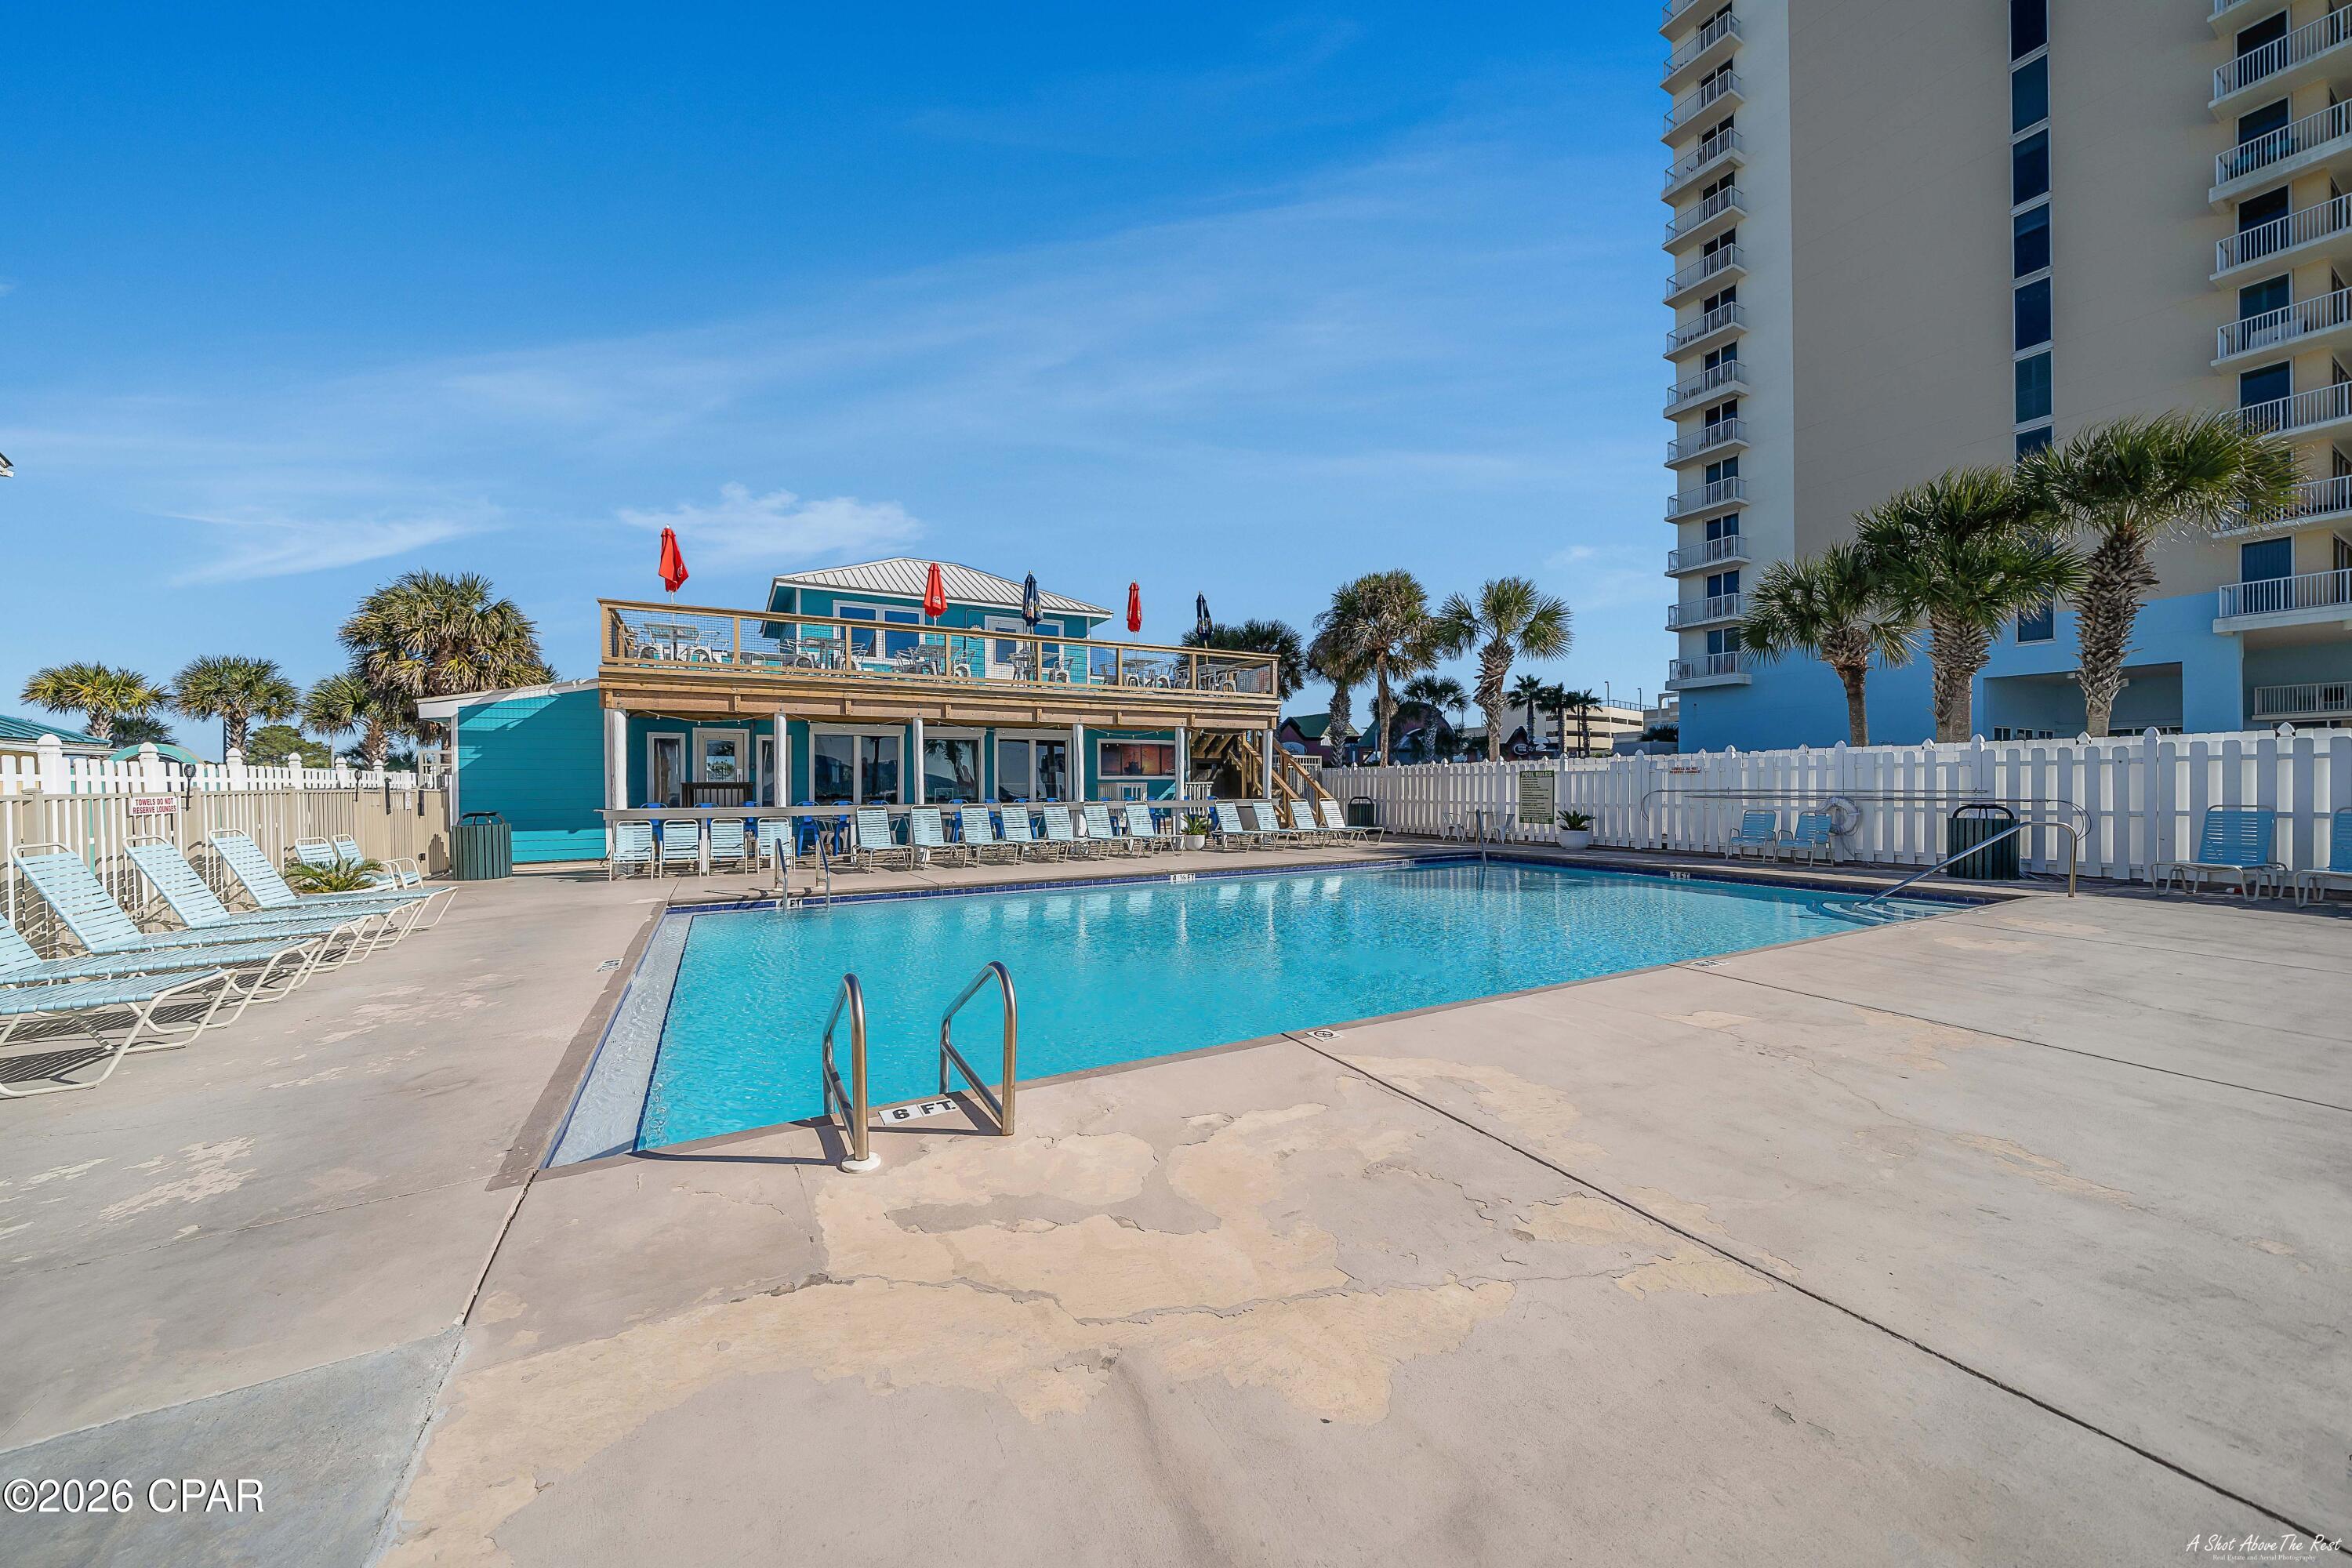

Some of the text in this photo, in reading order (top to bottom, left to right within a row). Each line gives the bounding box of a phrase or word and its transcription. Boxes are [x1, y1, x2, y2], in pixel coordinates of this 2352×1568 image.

[1187, 873, 1194, 882] FT
[892, 1100, 956, 1120] 6 FT.
